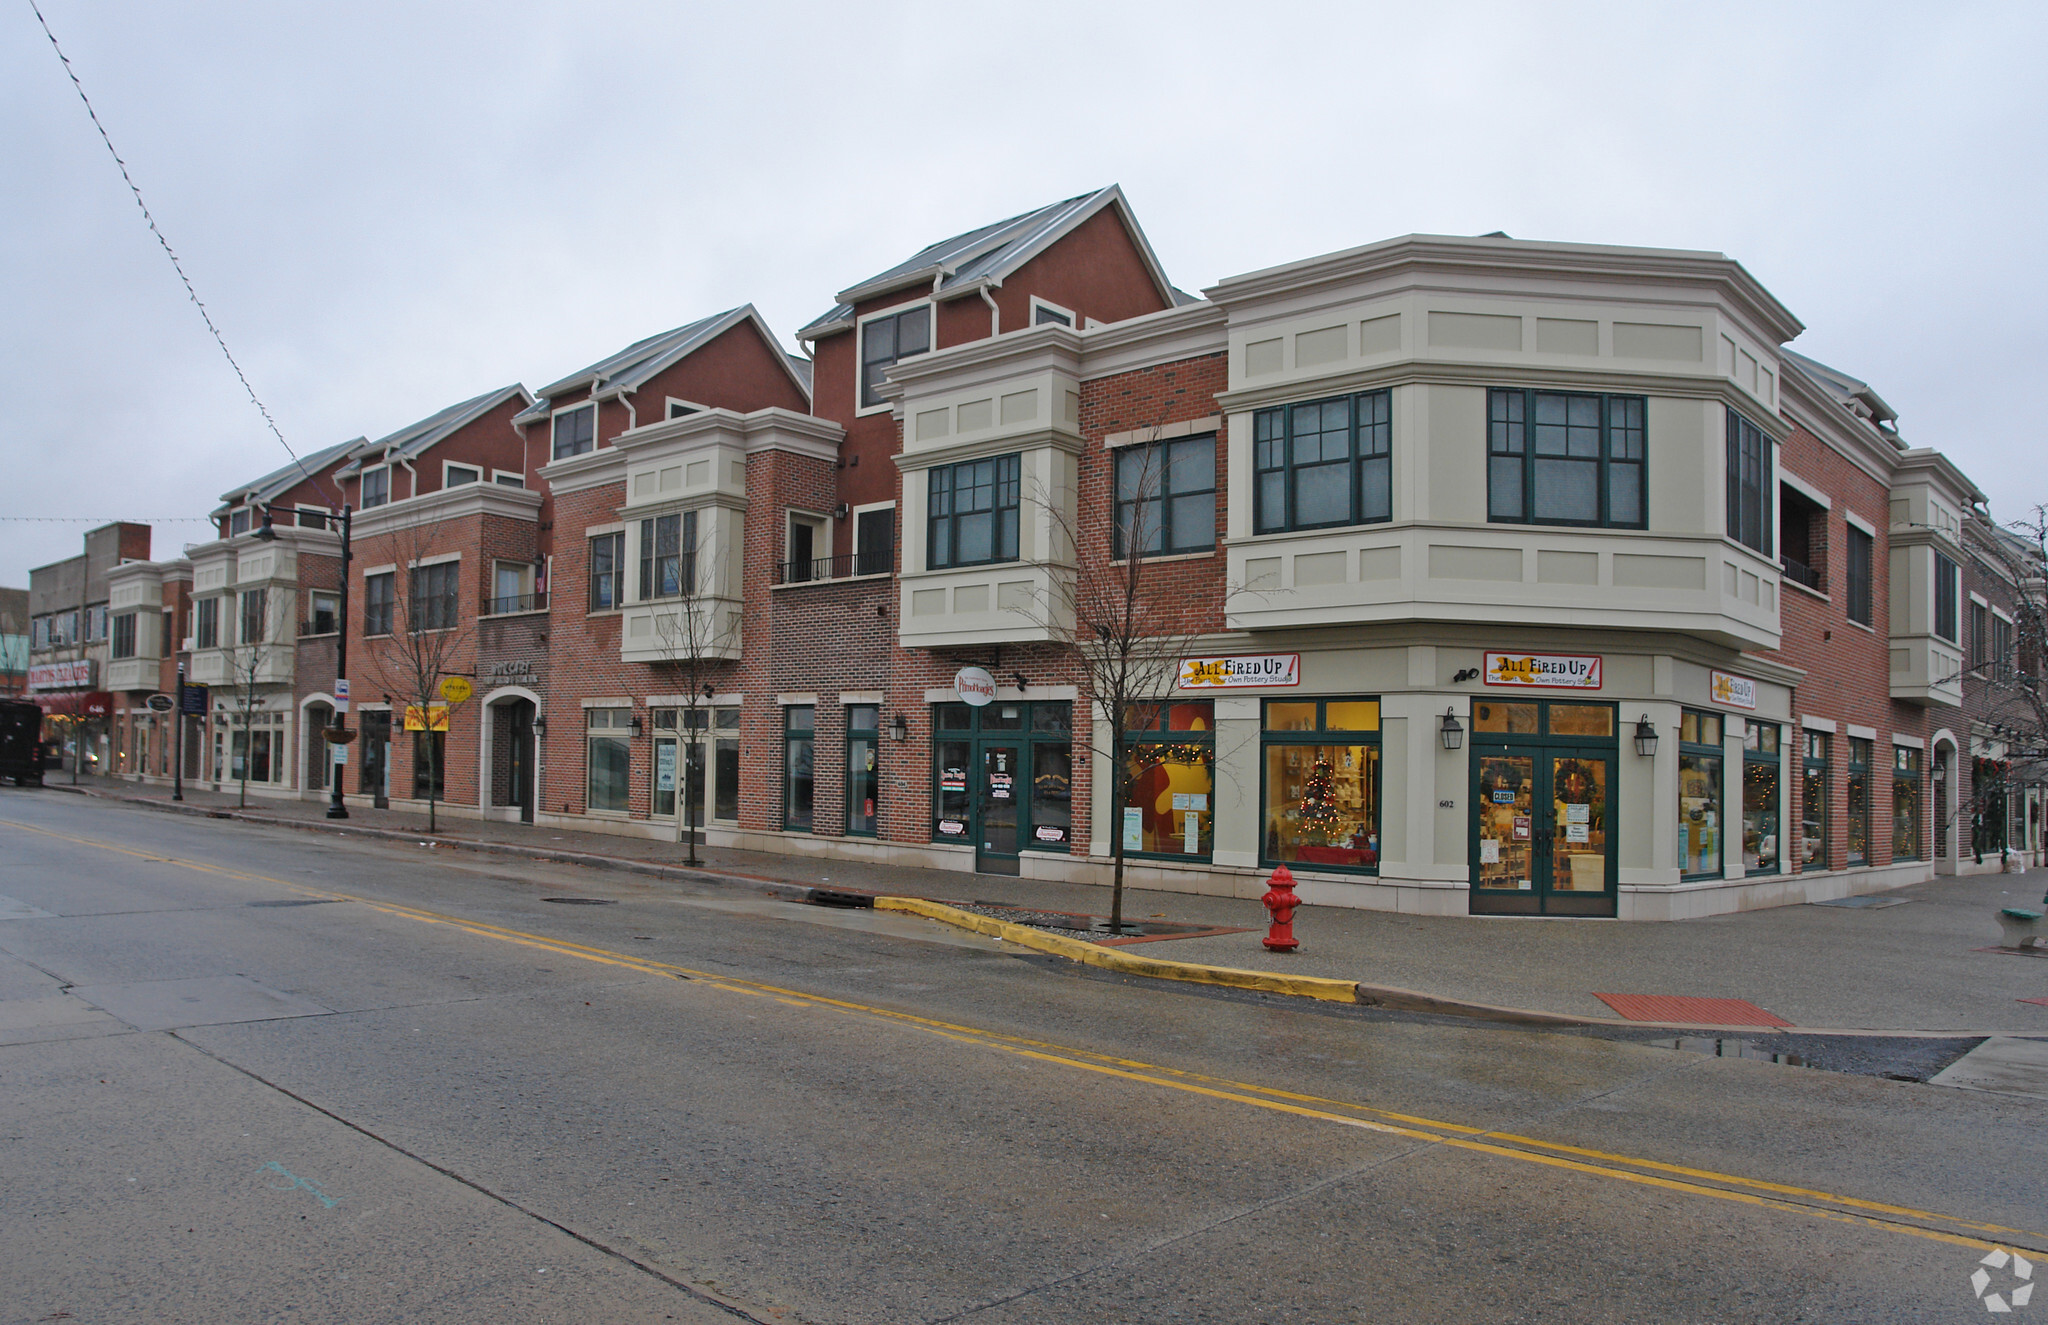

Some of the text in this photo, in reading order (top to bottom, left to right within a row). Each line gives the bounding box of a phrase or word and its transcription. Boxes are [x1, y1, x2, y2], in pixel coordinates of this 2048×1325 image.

[1194, 661, 1220, 676] ALL
[1264, 658, 1282, 674] UP
[1498, 657, 1525, 672] ALL
[1569, 660, 1587, 675] UP
[1228, 675, 1243, 684] Own
[1243, 675, 1269, 684] Pottery
[1488, 674, 1500, 682] The
[1536, 676, 1550, 684] Own
[1551, 677, 1576, 687] Pottery
[1494, 792, 1514, 801] CLOSED
[1439, 800, 1454, 808] 602
